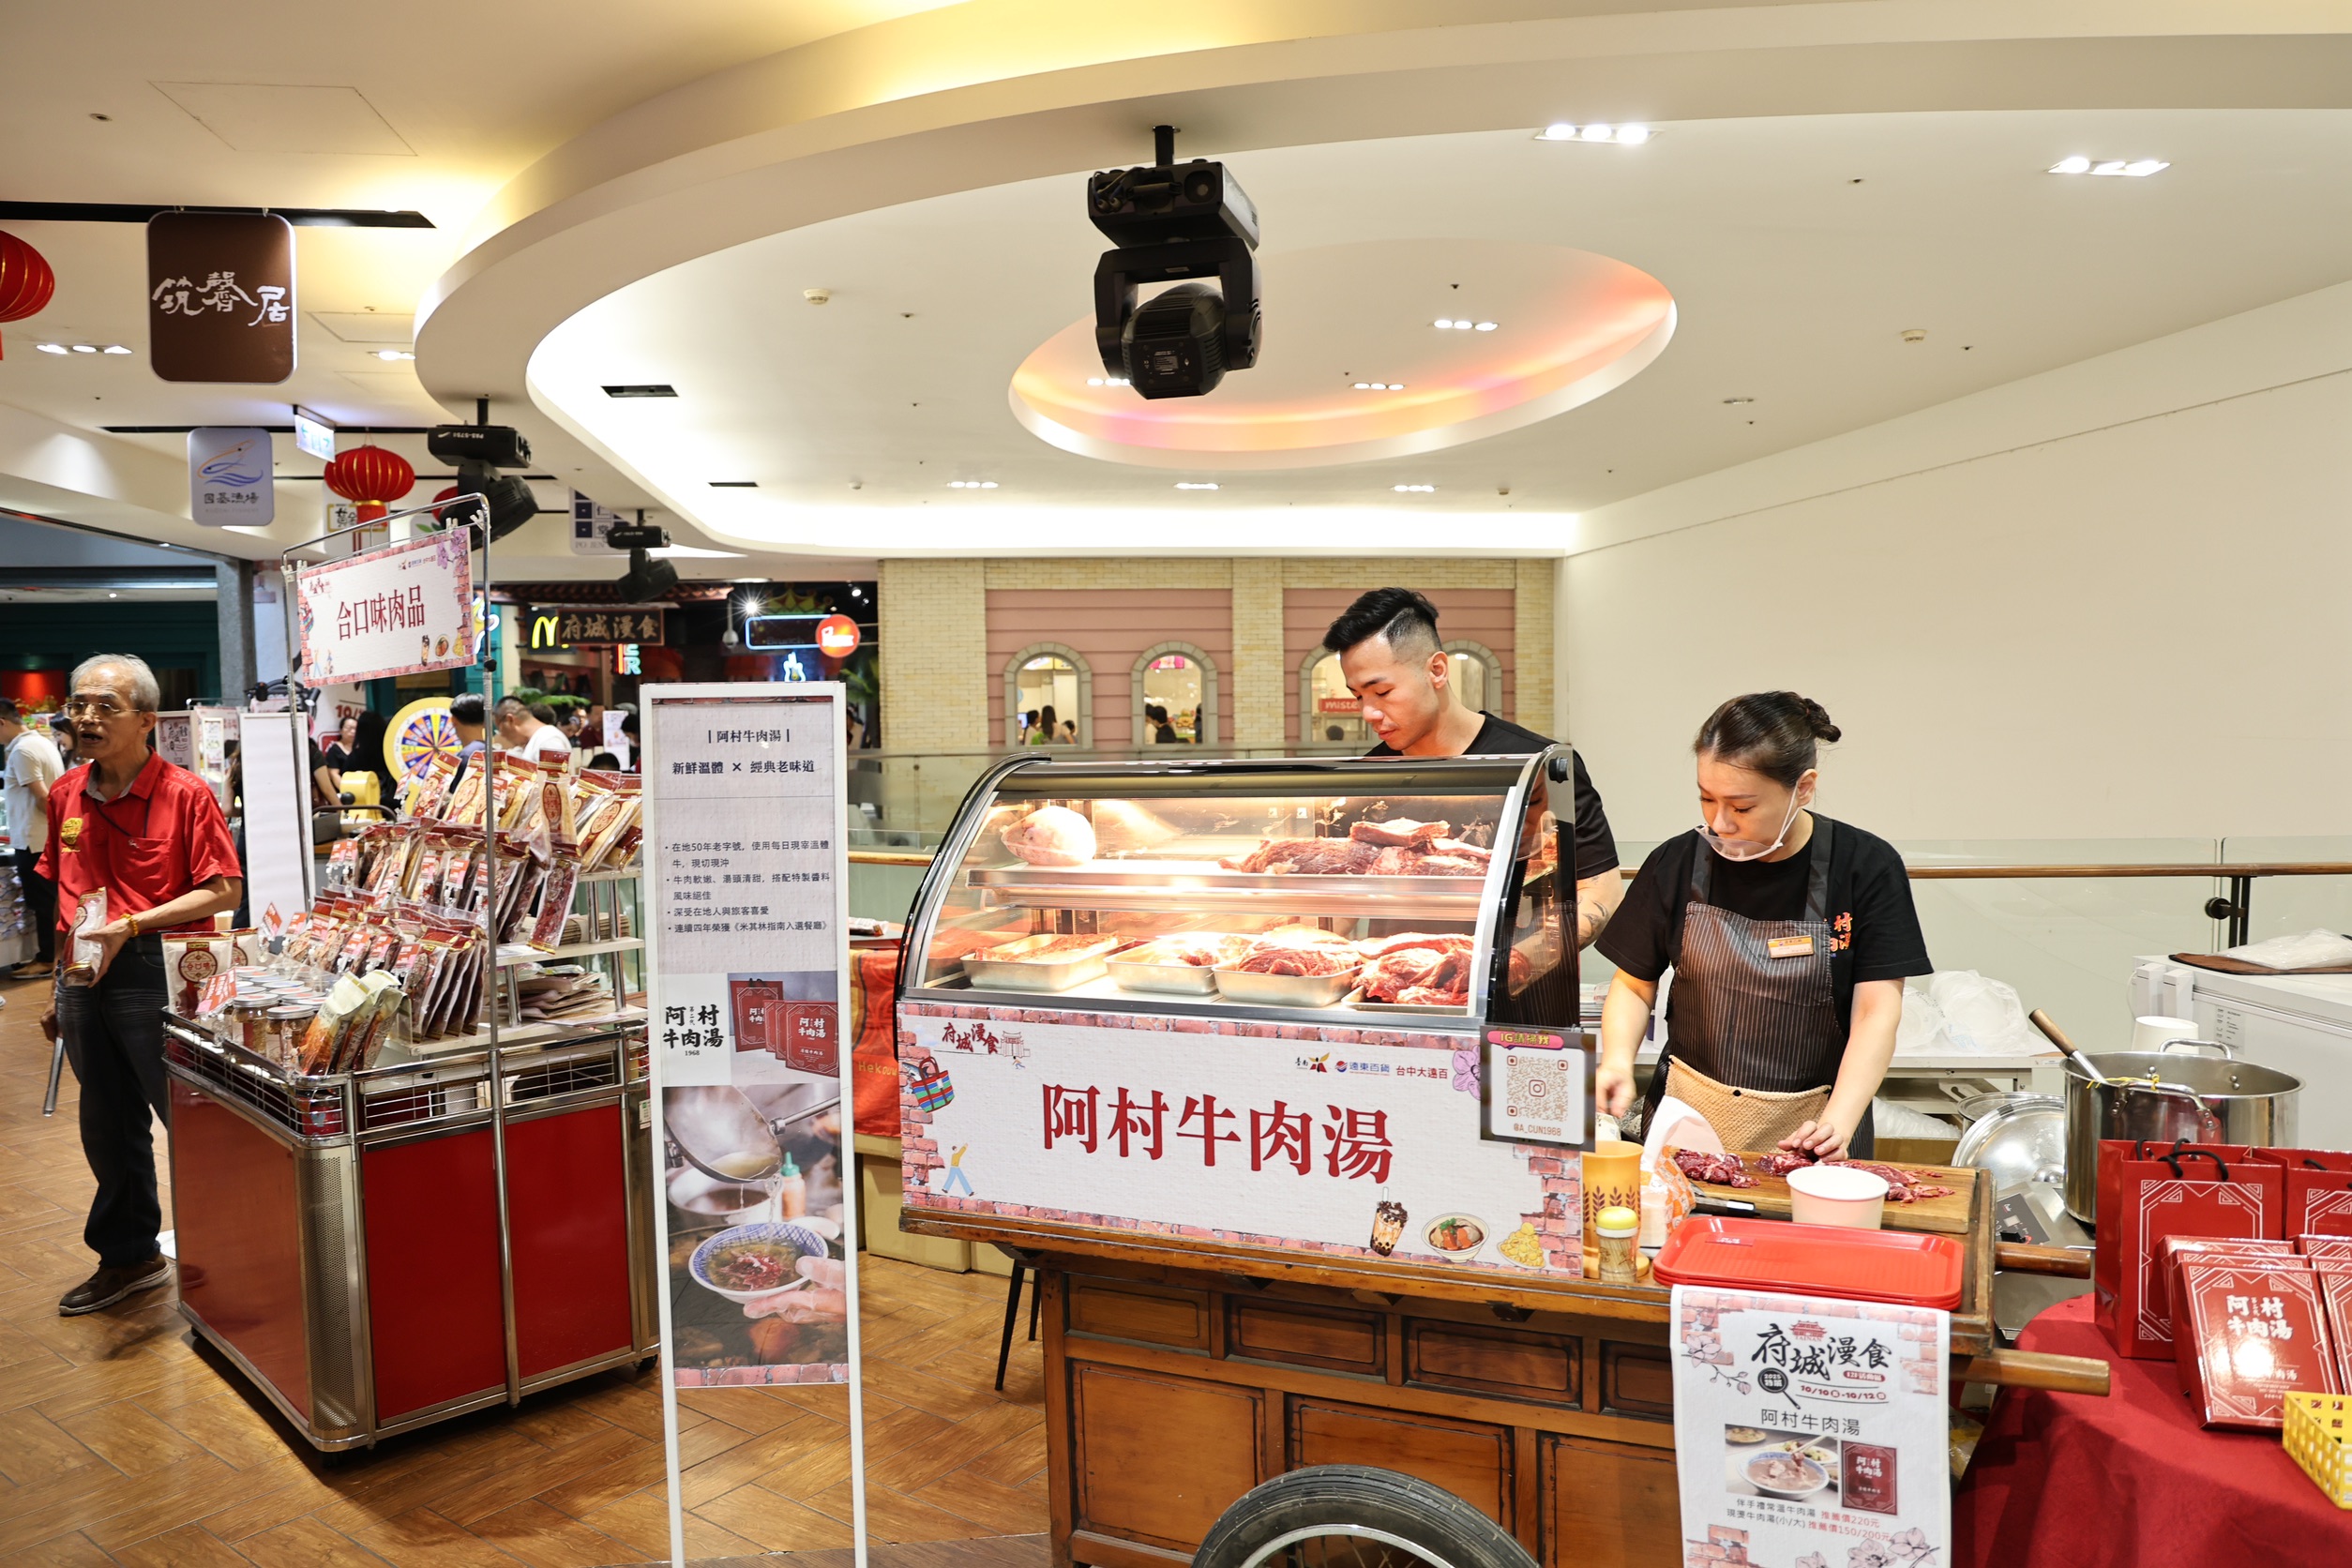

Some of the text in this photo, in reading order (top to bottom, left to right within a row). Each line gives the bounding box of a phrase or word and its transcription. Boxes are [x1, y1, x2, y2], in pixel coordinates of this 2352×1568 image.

[152, 271, 290, 326] 筑馨居
[337, 585, 425, 641] 合口味肉品
[561, 613, 659, 641] 府城漫食
[716, 730, 781, 743] 阿村牛肉湯
[672, 761, 724, 775] 新鮮溫體
[750, 760, 815, 774] 經典老味道
[673, 905, 769, 917] 深受在地人與旅客喜愛
[662, 1027, 724, 1048] 牛肉湯
[942, 1022, 1001, 1054] 府城漫食
[1349, 1062, 1390, 1073] 遠東百貨
[1395, 1065, 1448, 1079] 台中大遠百
[1042, 1083, 1394, 1184] 阿村牛肉湯
[2226, 1315, 2294, 1340] 牛肉湯
[1751, 1323, 1892, 1380] 府城漫食
[1761, 1409, 1861, 1436] 阿村牛肉湯
